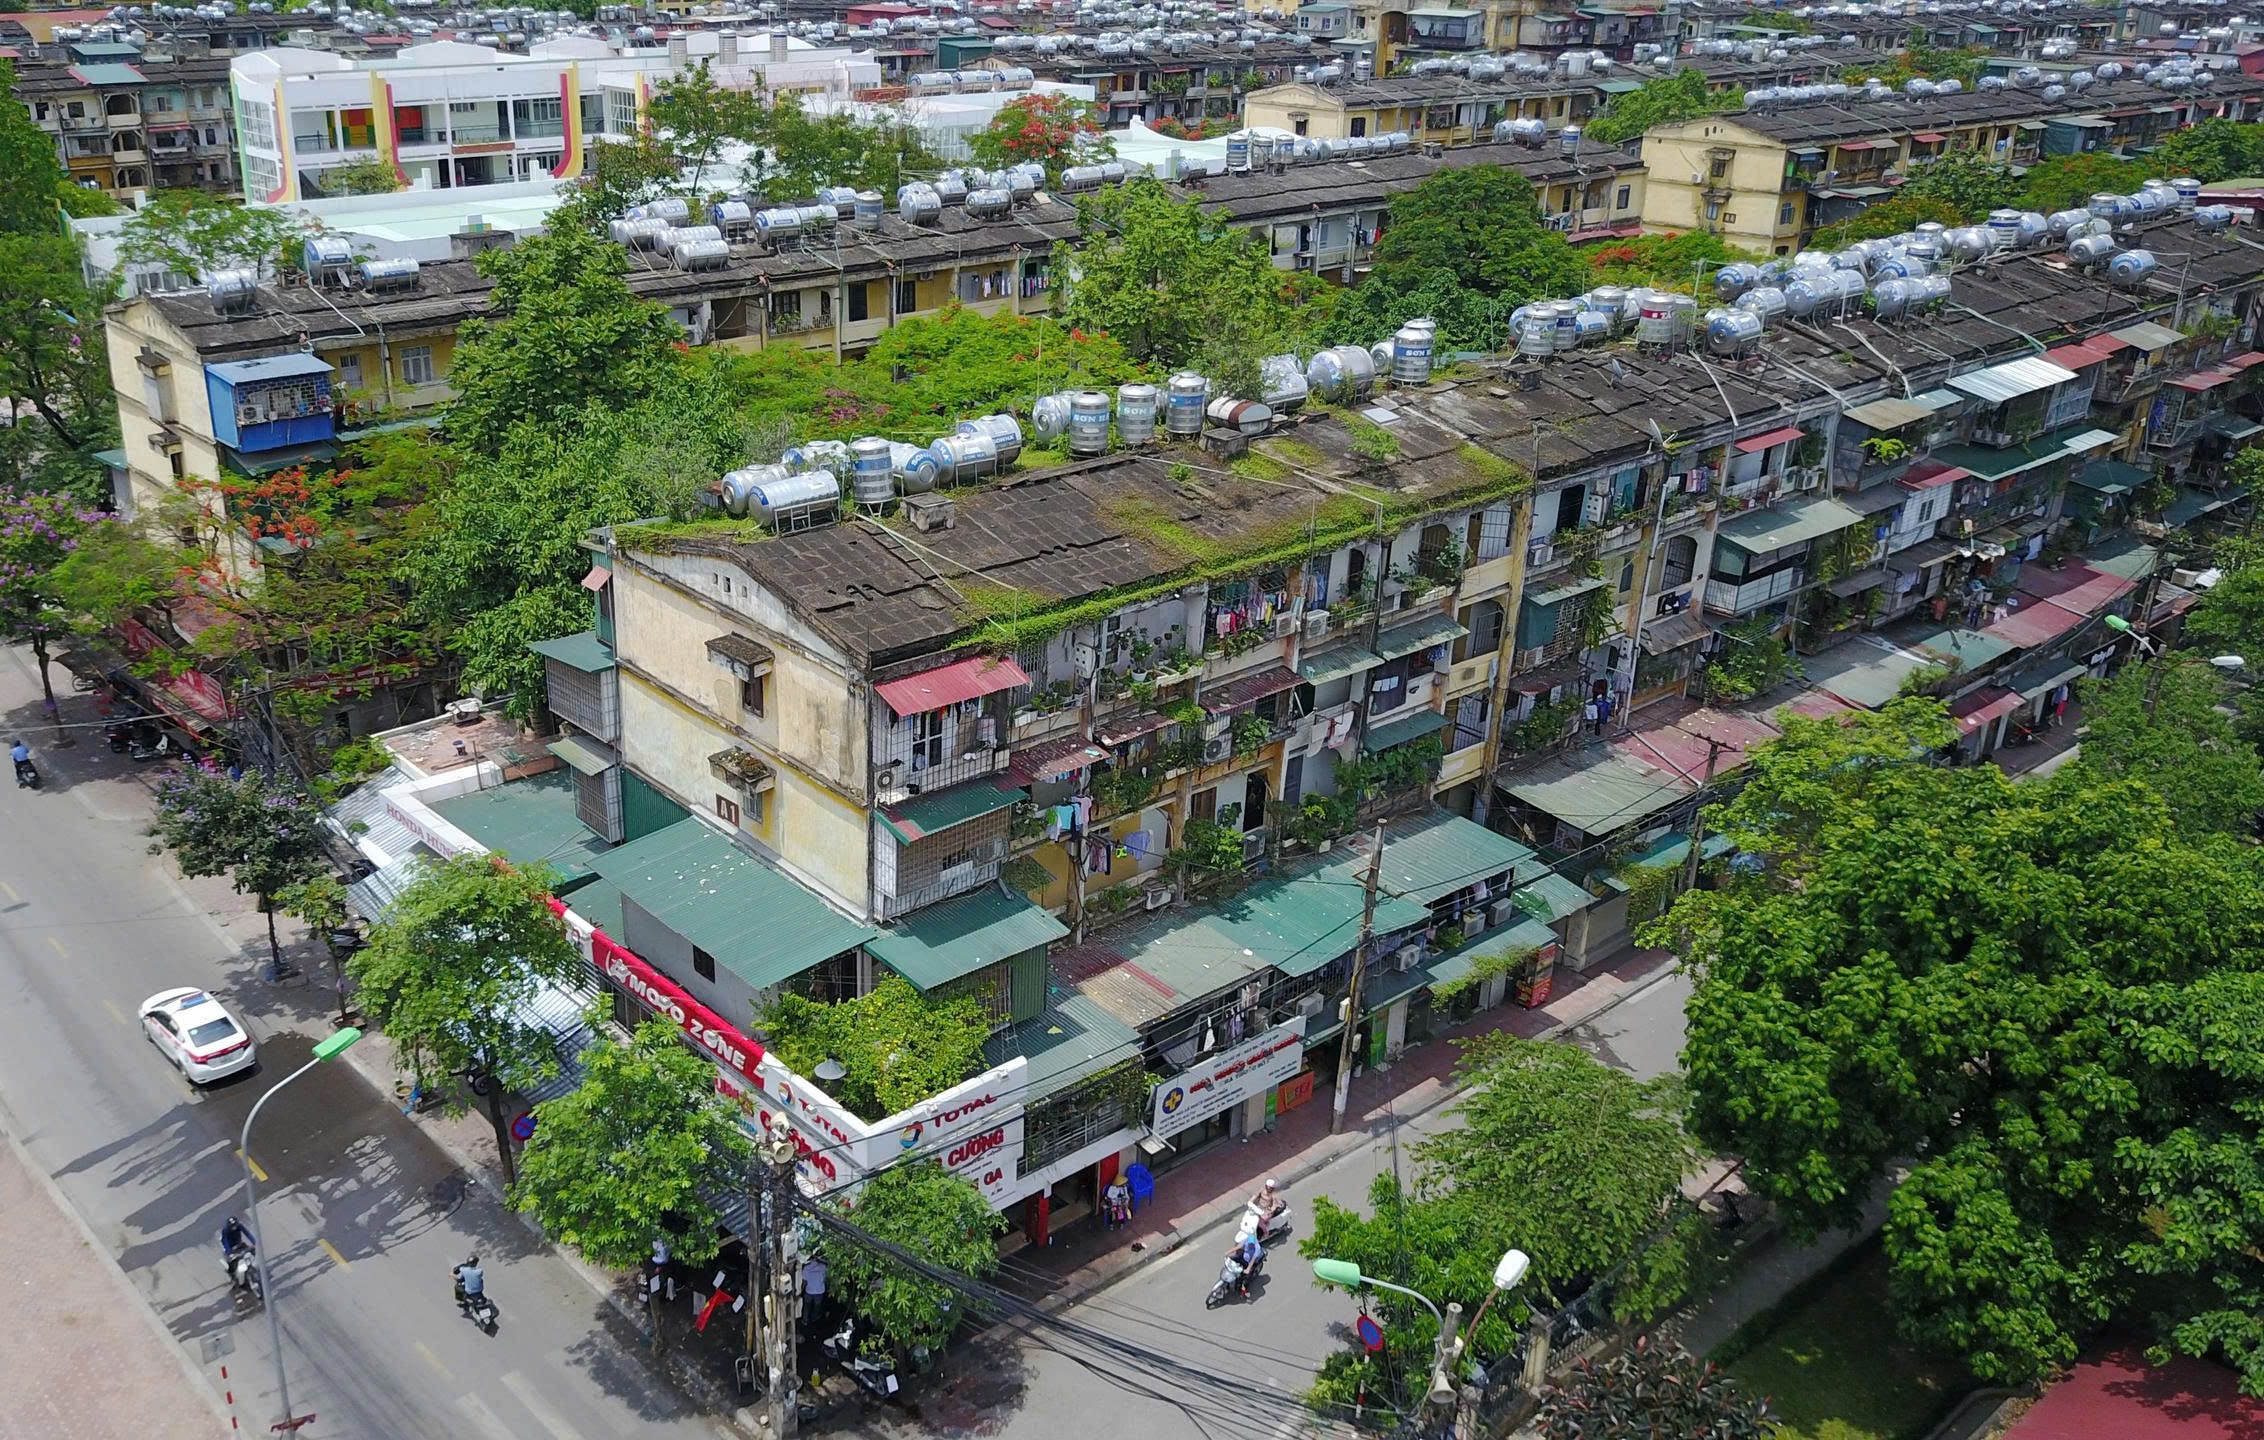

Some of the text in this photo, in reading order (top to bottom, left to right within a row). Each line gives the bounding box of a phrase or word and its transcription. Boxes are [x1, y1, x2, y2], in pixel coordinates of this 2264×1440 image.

[386, 803, 424, 839] HONDA
[720, 799, 736, 823] A1
[690, 1018, 746, 1070] ZONE
[934, 1093, 997, 1128] TOTAL
[984, 1167, 1003, 1186] GA
